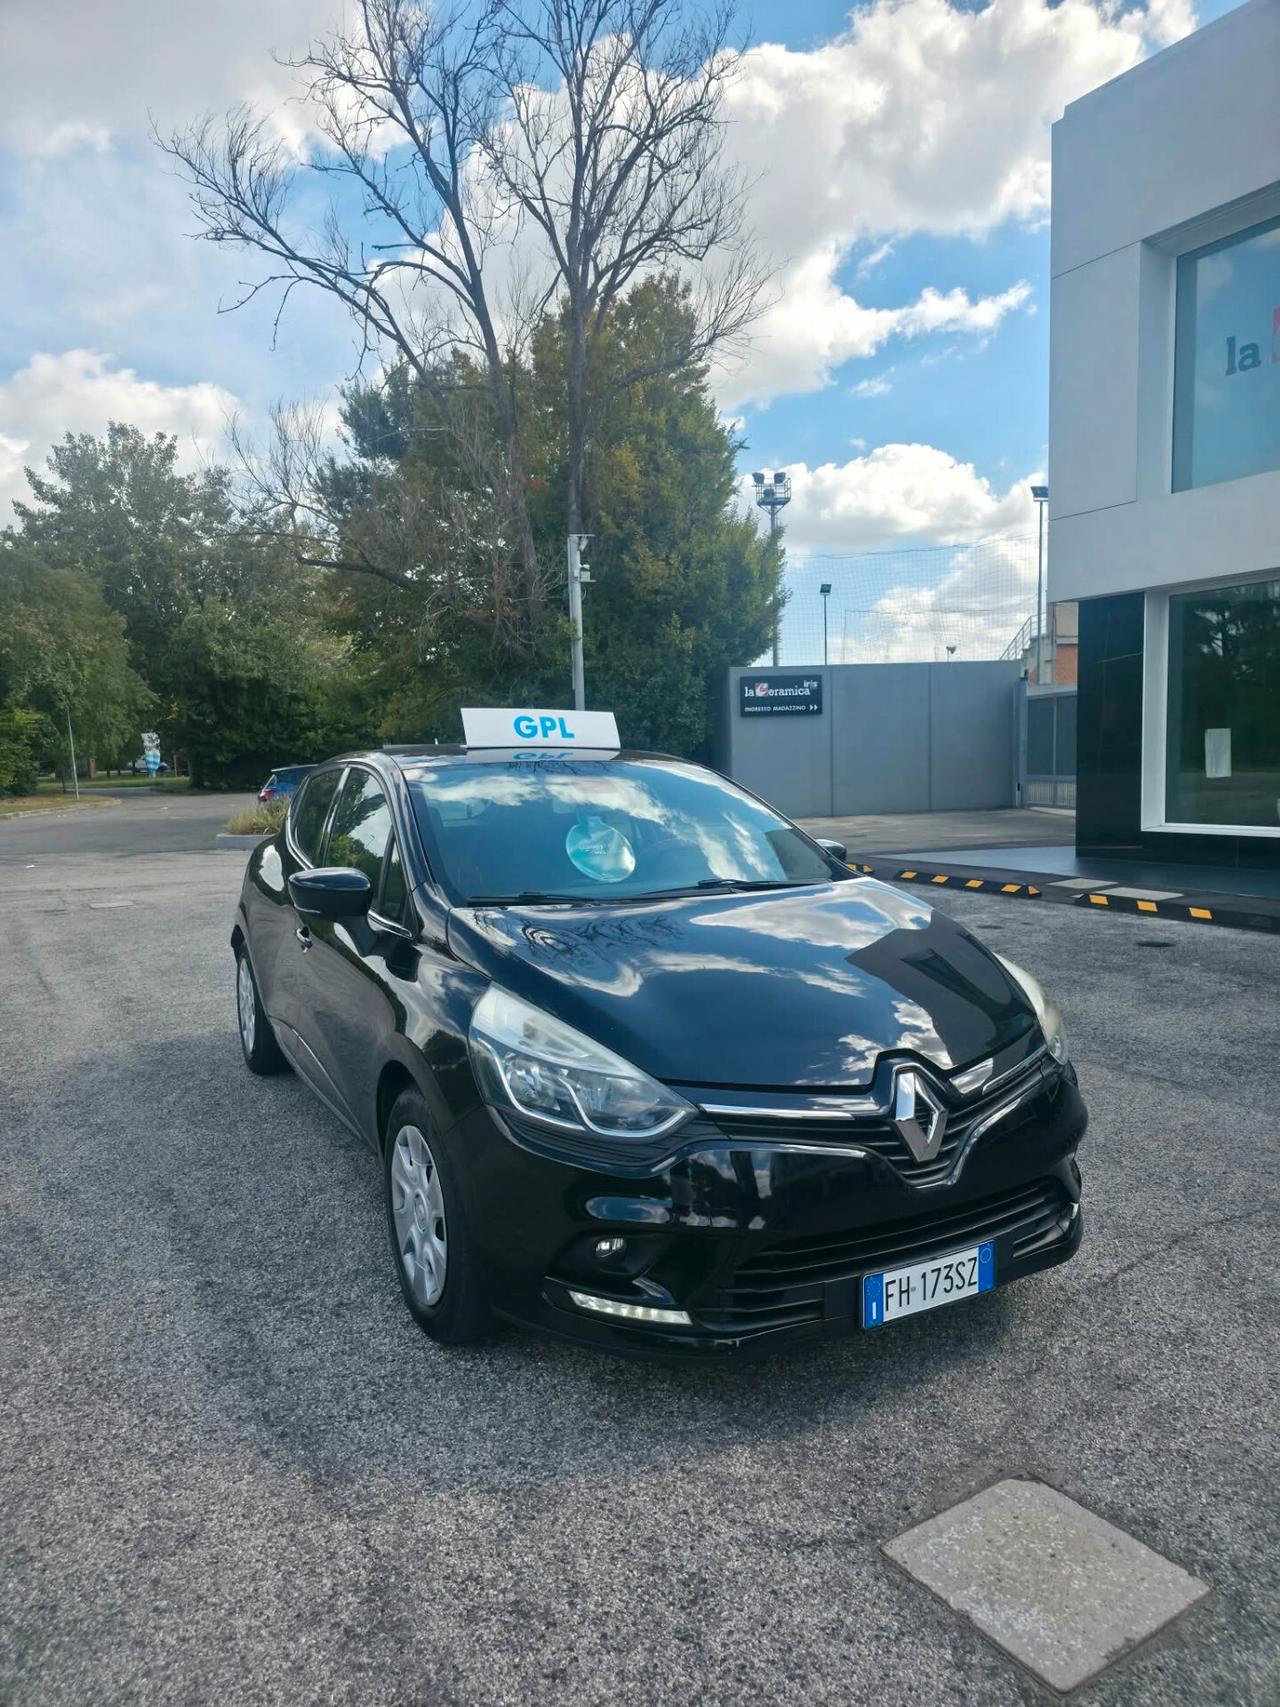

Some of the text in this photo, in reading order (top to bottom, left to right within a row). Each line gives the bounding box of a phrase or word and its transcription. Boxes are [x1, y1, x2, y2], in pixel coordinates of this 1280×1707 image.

[1225, 336, 1262, 376] la
[513, 715, 575, 739] GPL
[872, 1302, 877, 1320] I
